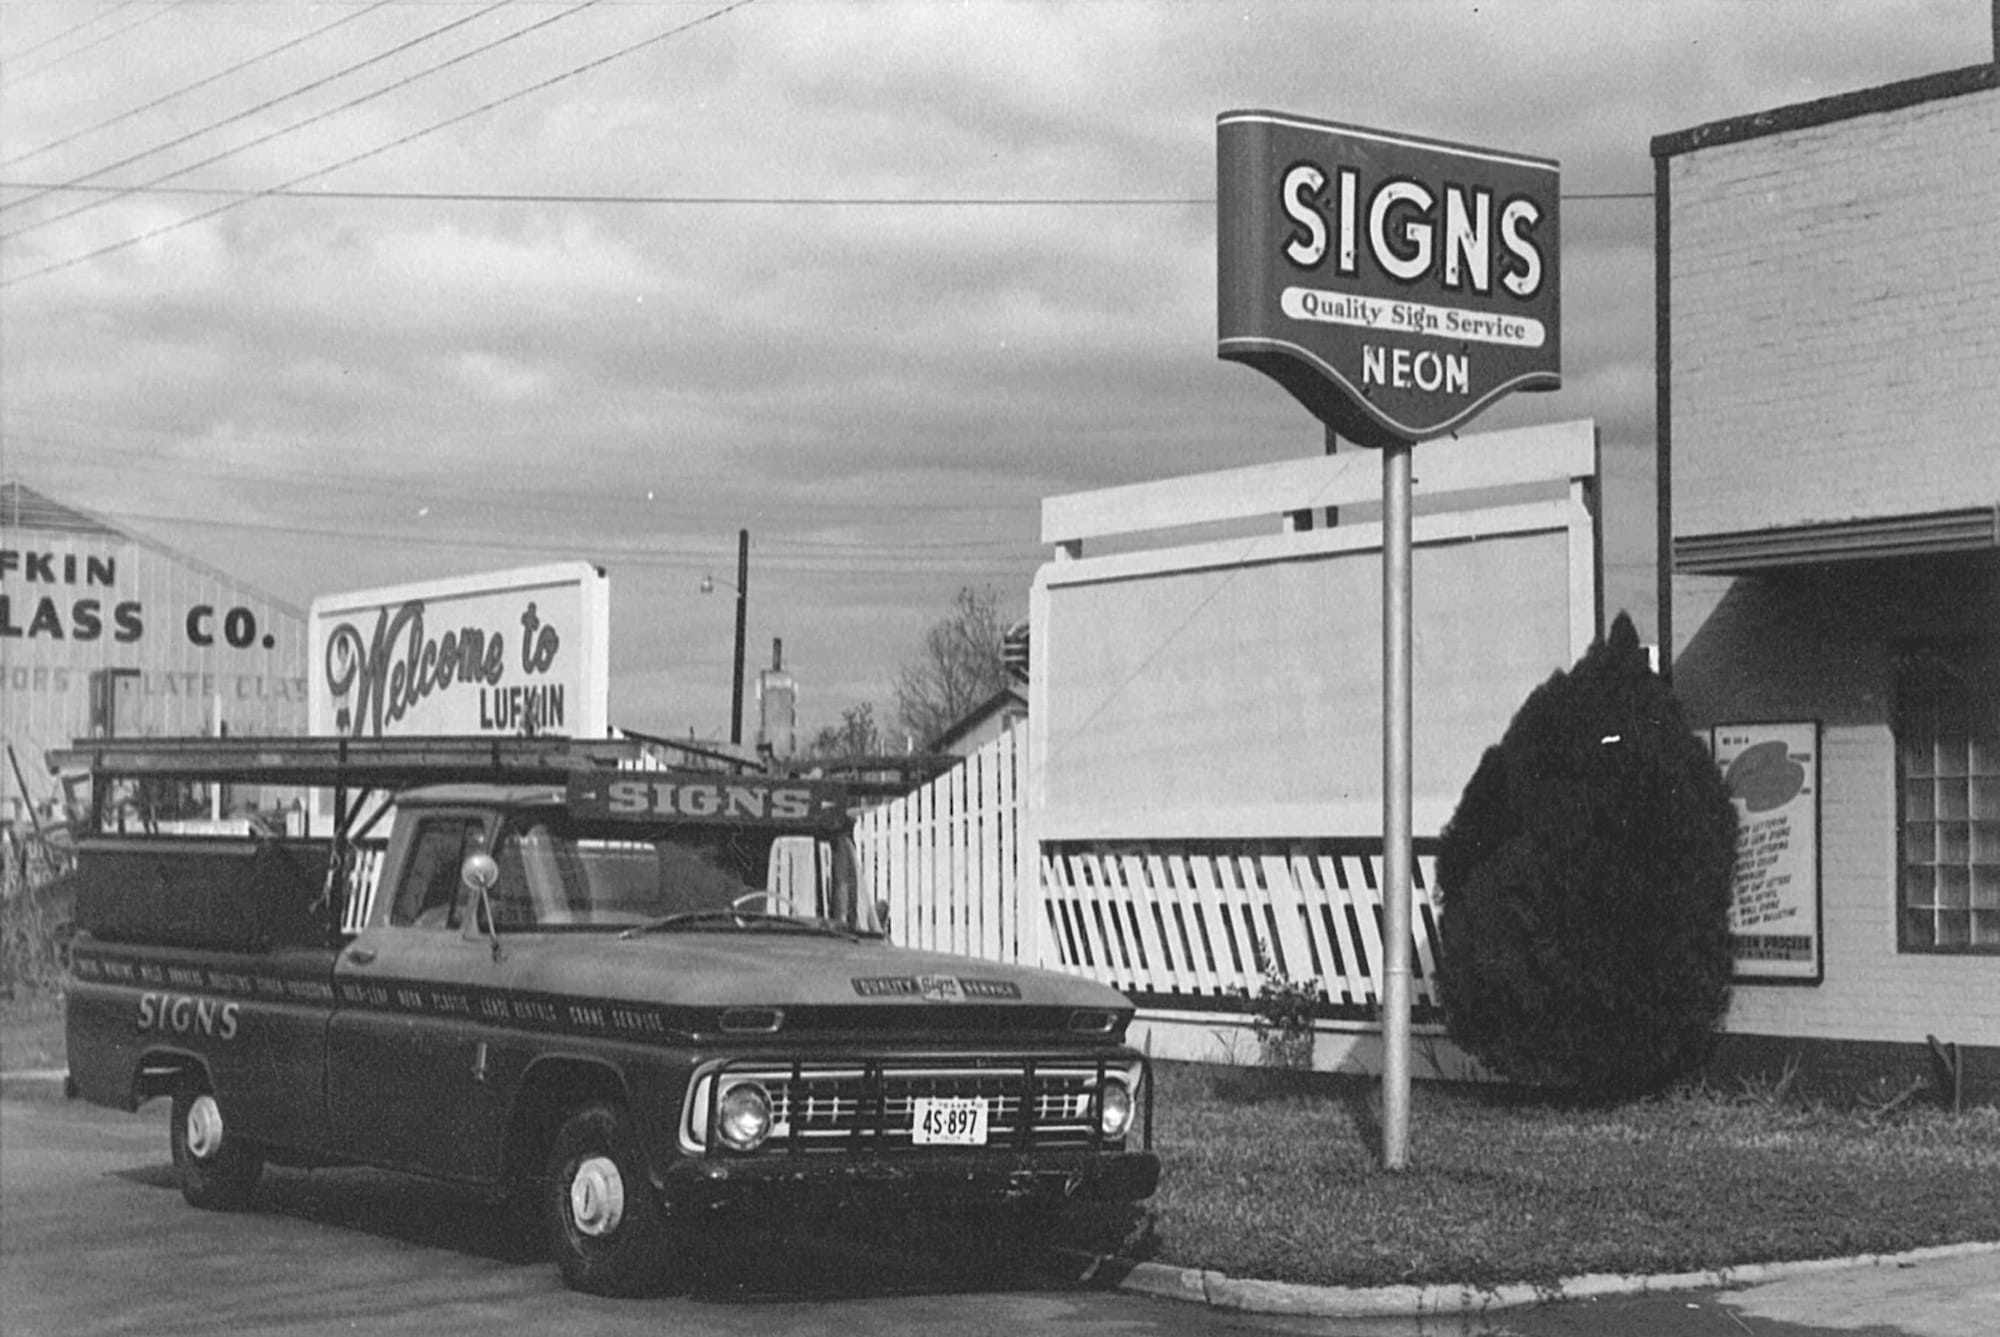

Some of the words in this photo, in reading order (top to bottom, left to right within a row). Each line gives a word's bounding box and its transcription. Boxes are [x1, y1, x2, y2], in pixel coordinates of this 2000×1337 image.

[1282, 164, 1542, 297] SIGNS
[1301, 292, 1382, 325] Quality
[1391, 304, 1439, 332] Sign
[1446, 312, 1525, 340] Service
[1362, 345, 1469, 394] NEON
[0, 551, 115, 587] FKIN
[0, 594, 143, 643] LASS
[186, 604, 275, 649] CO.
[326, 600, 504, 738] Welcome
[521, 602, 560, 674] to
[480, 684, 564, 729] LUFKIN
[608, 781, 811, 818] SIGNS
[138, 992, 240, 1039] SIGNS
